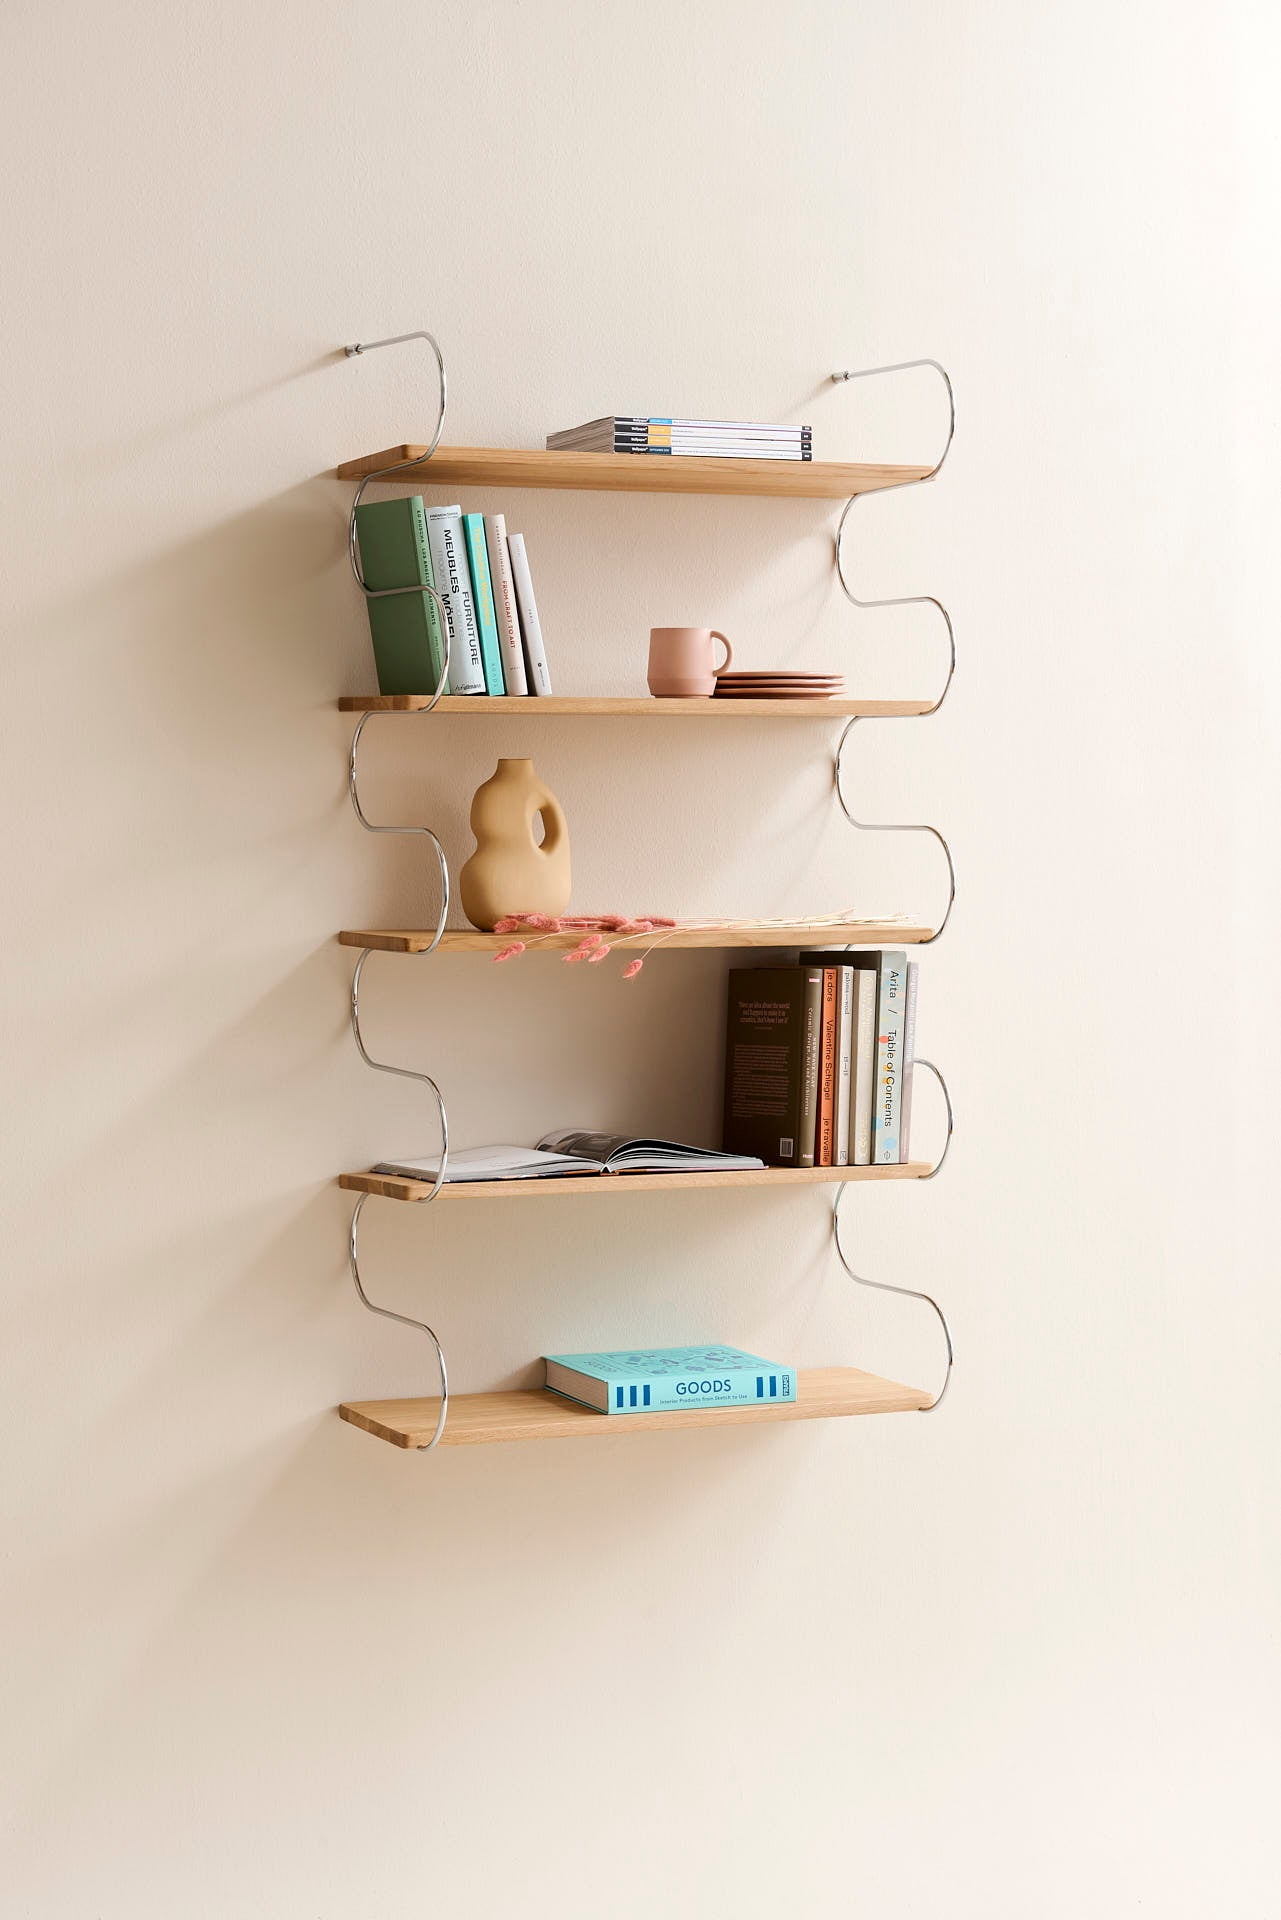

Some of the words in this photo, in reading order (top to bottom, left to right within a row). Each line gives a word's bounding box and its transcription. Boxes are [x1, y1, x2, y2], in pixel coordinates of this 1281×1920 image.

[417, 520, 425, 544] RUSCHA
[444, 529, 460, 594] MEUBLES
[462, 591, 479, 666] FURNITURE
[508, 625, 514, 635] TO
[826, 971, 835, 980] je
[889, 970, 899, 998] Arita
[827, 983, 835, 1002] dors
[825, 1019, 833, 1060] Valentine
[886, 1030, 897, 1059] Table
[824, 1063, 833, 1100] Schlegel
[886, 1062, 895, 1073] of
[884, 1077, 895, 1127] Contents
[823, 1118, 831, 1126] je
[822, 1128, 832, 1162] travaille
[676, 1379, 732, 1395] GOODS
